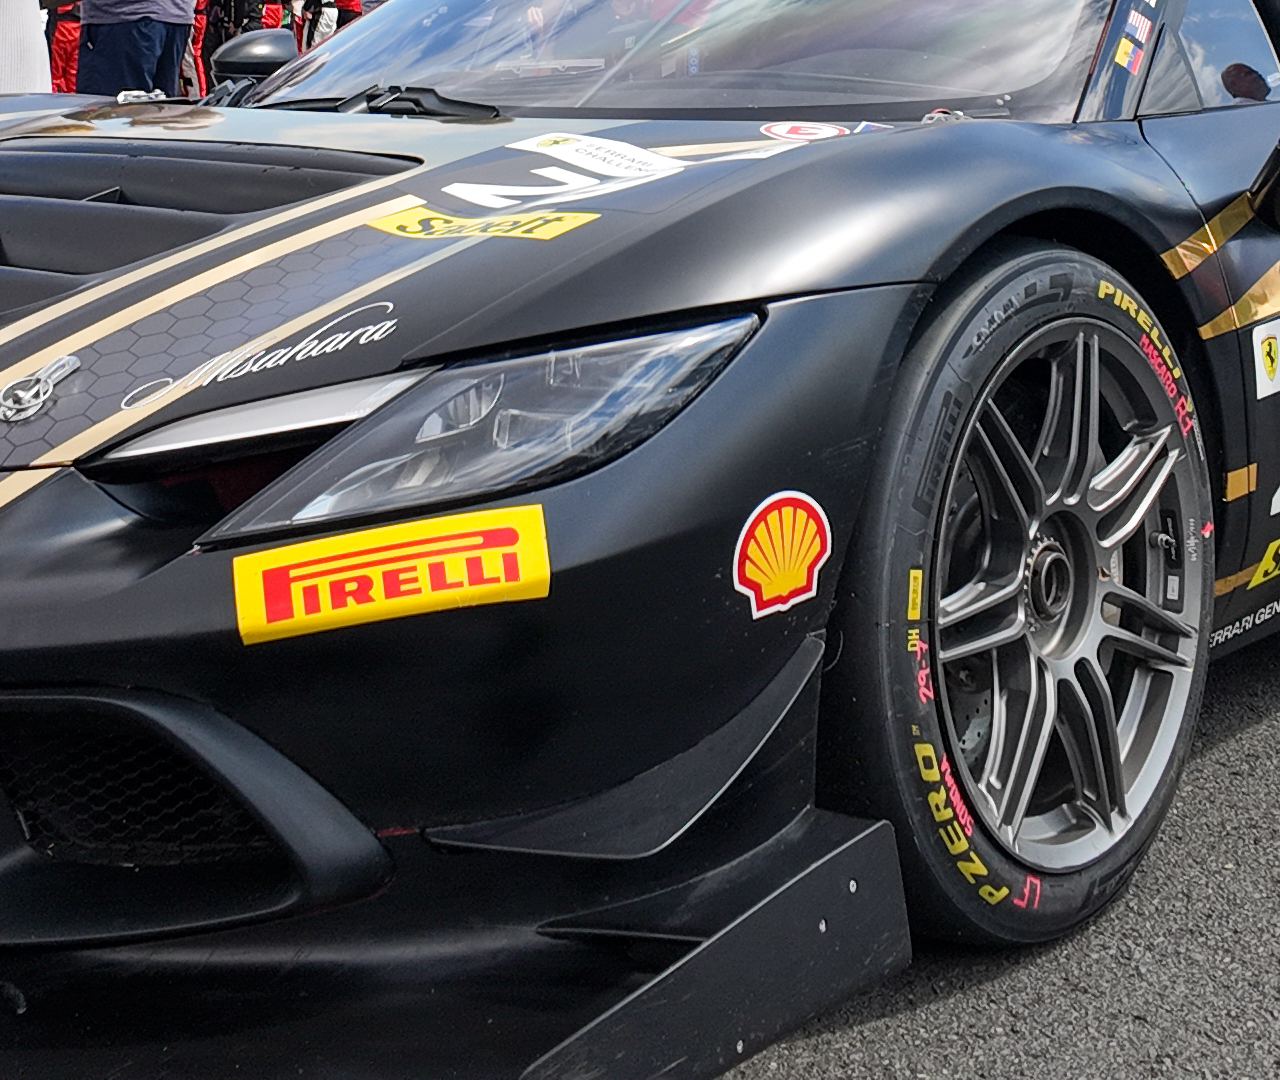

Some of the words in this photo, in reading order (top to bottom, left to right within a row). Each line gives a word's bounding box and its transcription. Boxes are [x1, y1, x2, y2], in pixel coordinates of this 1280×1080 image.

[1098, 279, 1182, 379] PIRELLI
[261, 526, 520, 625] PIRELLI
[940, 752, 975, 837] SONOMA
